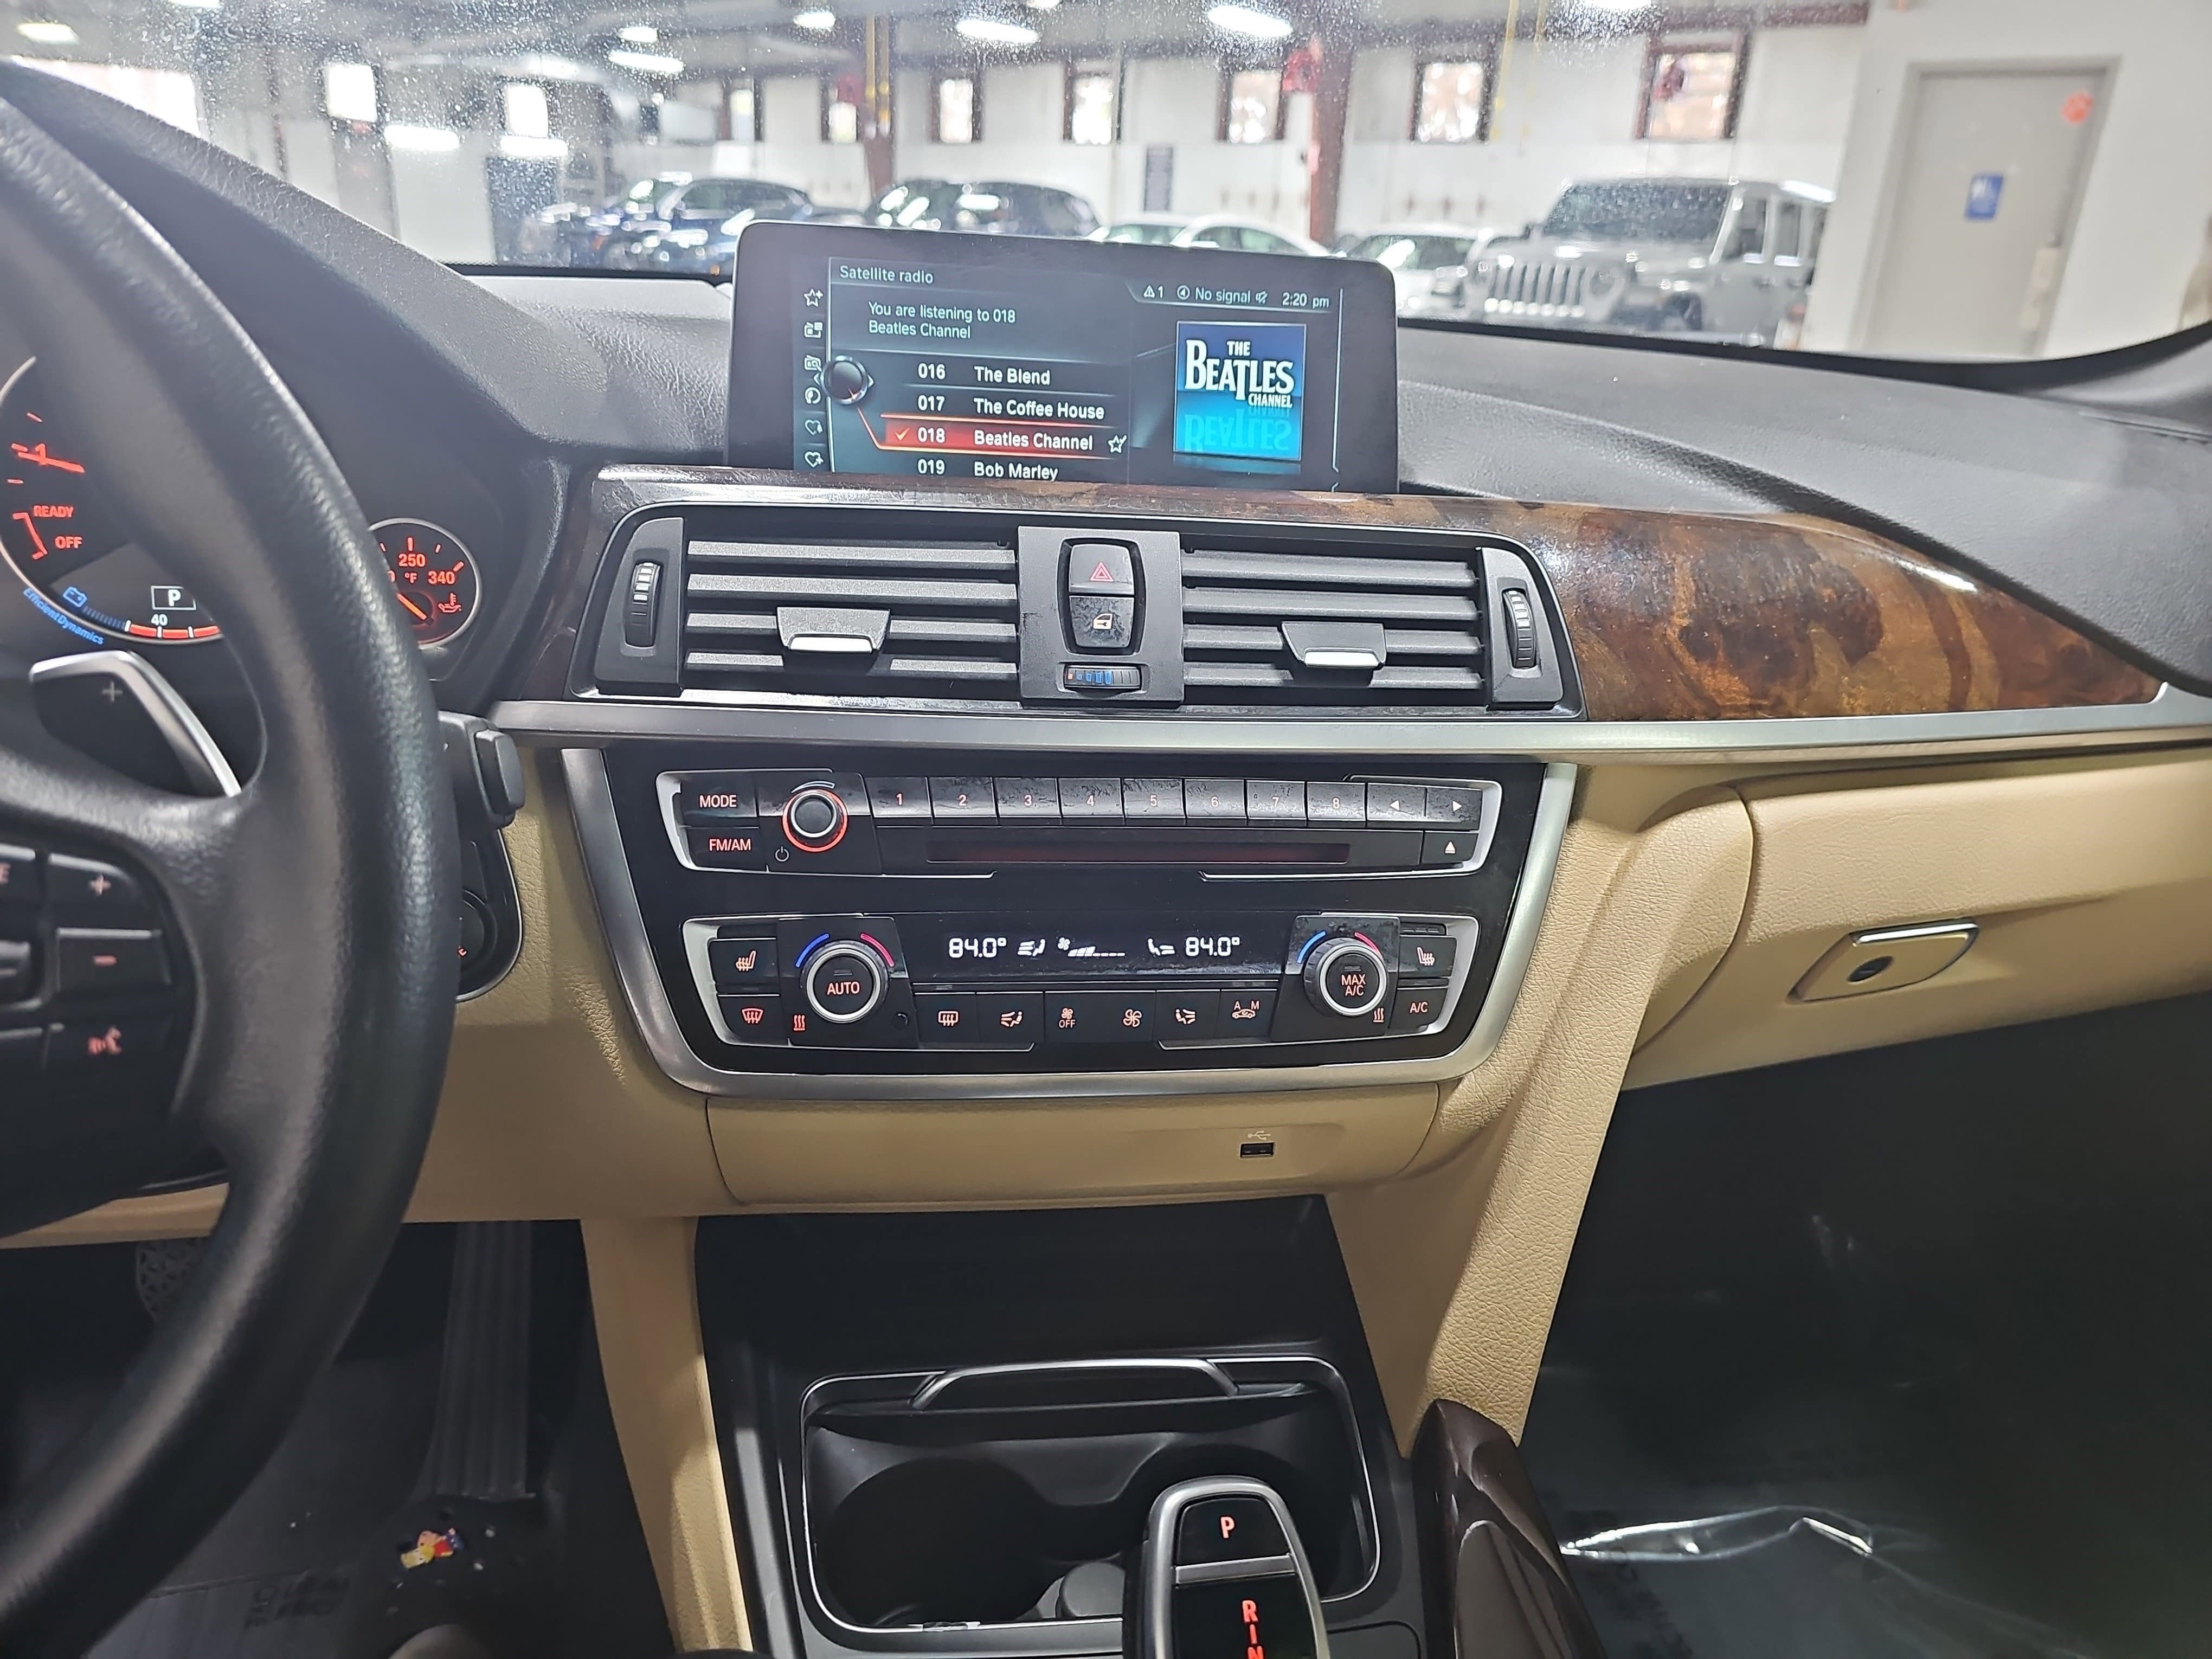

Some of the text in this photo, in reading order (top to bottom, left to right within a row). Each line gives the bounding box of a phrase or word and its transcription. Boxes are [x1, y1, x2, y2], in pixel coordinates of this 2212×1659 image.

[840, 265, 934, 285] Satellite radio
[1158, 285, 1329, 309] 1 No signal 2:20 pm
[868, 301, 1016, 323] You are listening to 018
[869, 320, 971, 339] Beatles Channel
[1226, 340, 1251, 357] THE
[917, 363, 1051, 385] 016 The Blend
[1184, 339, 1295, 401] BEATLES
[917, 395, 1104, 420] 017 The Coffee House
[1248, 393, 1293, 408] CHANNEL
[917, 427, 1093, 450] 018 Beatles Channel
[917, 459, 1058, 482] 019 Bob Marley
[33, 505, 75, 518] READY
[54, 536, 83, 550] OFF
[398, 553, 426, 568] 250
[427, 570, 456, 585] 340
[167, 589, 182, 607] P
[151, 613, 169, 627] 40
[699, 794, 737, 808] MODE
[896, 793, 903, 806] 1
[958, 794, 967, 807] 2
[1024, 794, 1032, 806] 3
[1086, 794, 1096, 807] 4
[1150, 795, 1158, 807] 5
[1210, 796, 1219, 808] 6
[1271, 796, 1280, 808] 7
[1332, 798, 1341, 809] 8
[709, 838, 751, 852] FM/AM
[948, 937, 1007, 959] 84.0°
[1185, 936, 1240, 957] 84.0°
[1341, 973, 1367, 986] MAX
[827, 981, 860, 996] AUTO
[1345, 985, 1365, 996] A/C
[1233, 1000, 1260, 1011] A M
[1409, 1001, 1429, 1014] A/C
[1058, 1019, 1076, 1029] OFF
[1220, 1516, 1235, 1539] P
[1242, 1599, 1259, 1623] R
